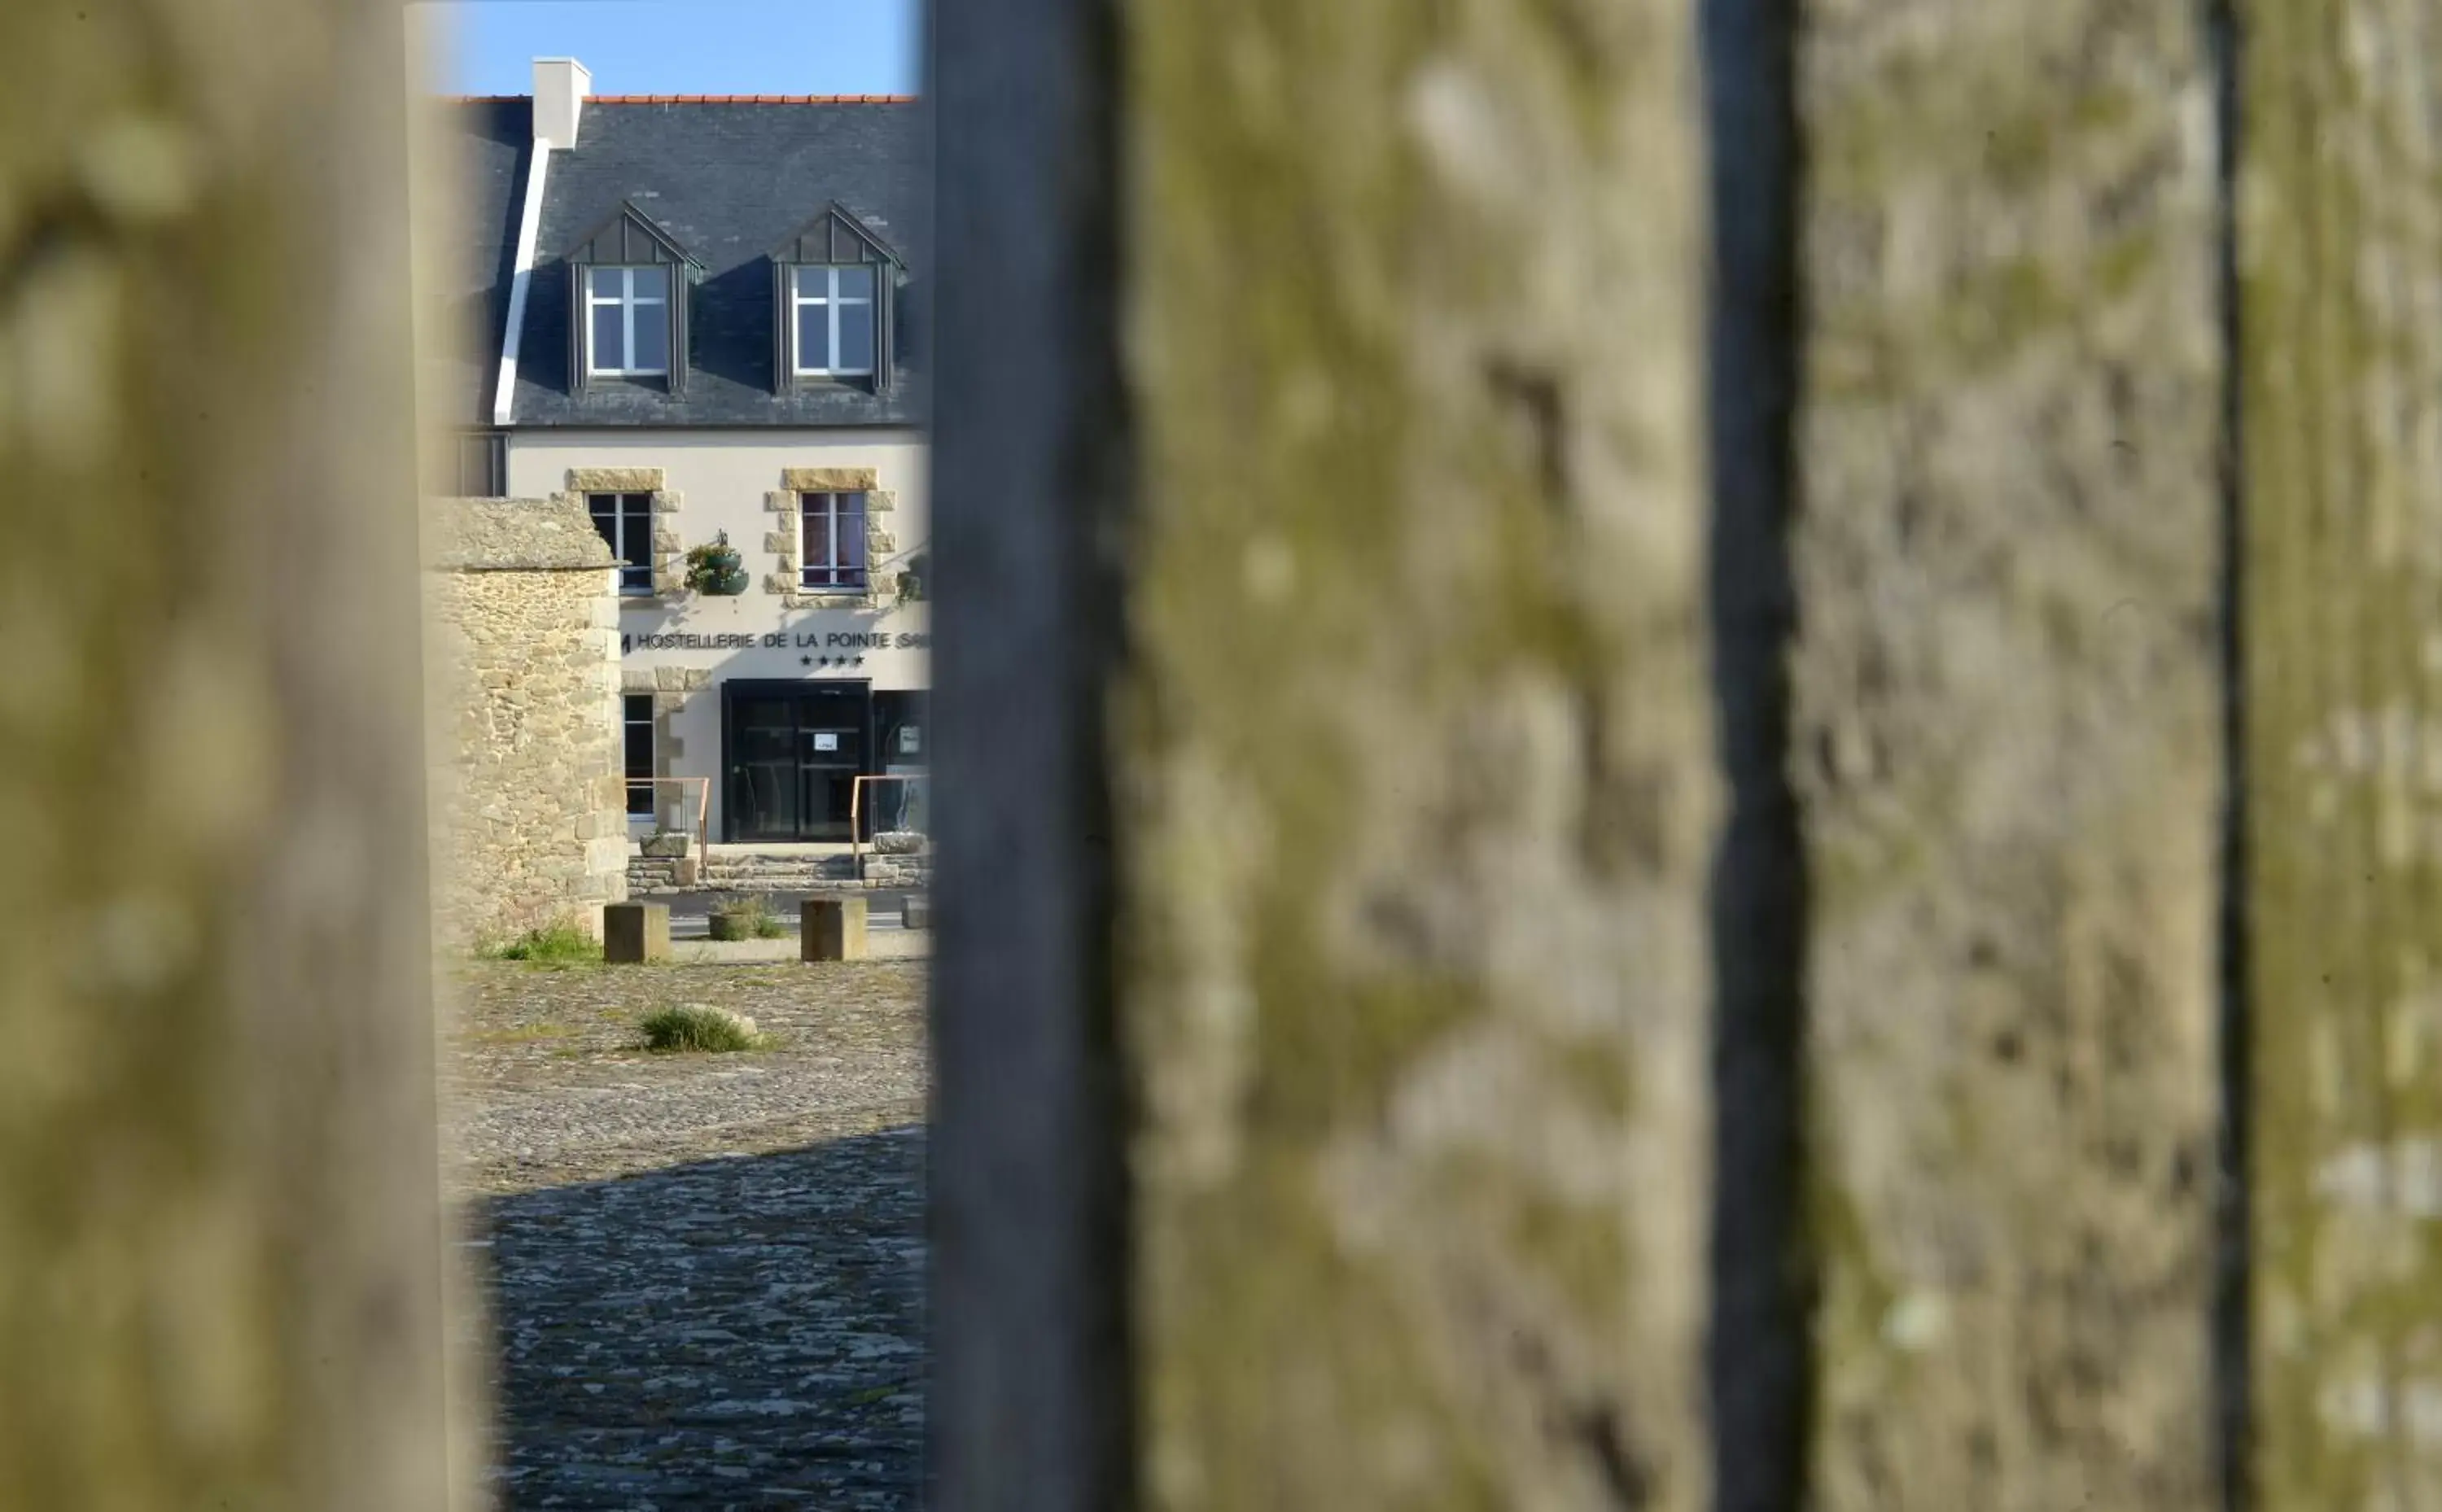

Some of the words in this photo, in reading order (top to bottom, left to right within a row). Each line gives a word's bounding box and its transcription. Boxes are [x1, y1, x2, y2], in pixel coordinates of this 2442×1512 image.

[637, 634, 755, 649] HOSTELLERIE
[764, 633, 788, 648] DE
[796, 633, 819, 648] LA
[827, 632, 891, 648] POINTE
